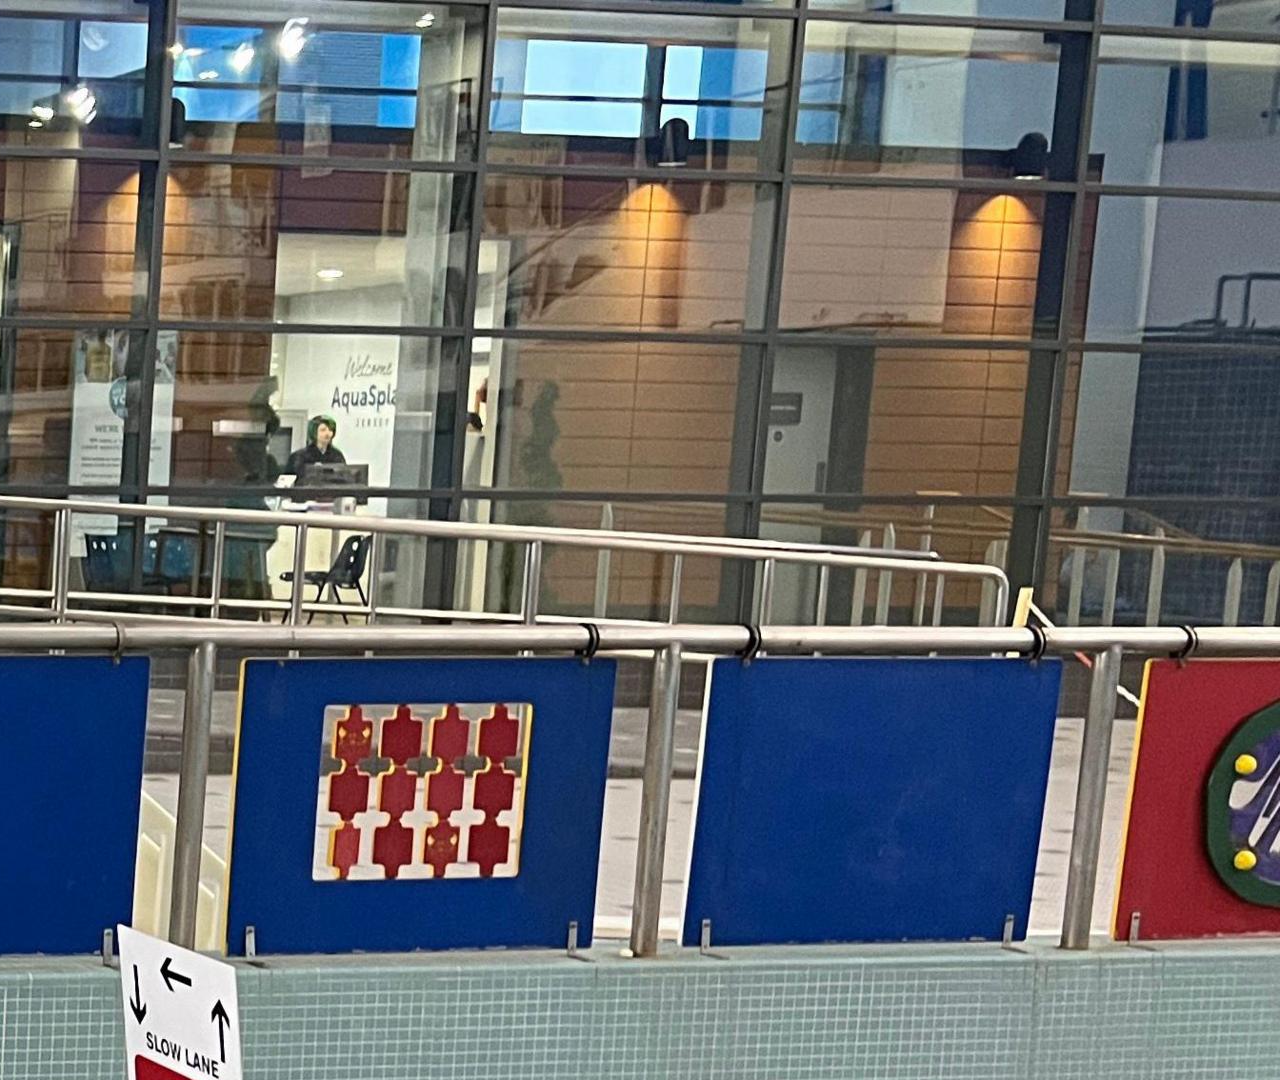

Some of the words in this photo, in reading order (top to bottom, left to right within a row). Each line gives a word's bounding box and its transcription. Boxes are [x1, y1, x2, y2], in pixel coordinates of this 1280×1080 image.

[344, 354, 392, 380] Welcome
[146, 1031, 181, 1062] SLOW
[185, 1048, 220, 1080] LANE
